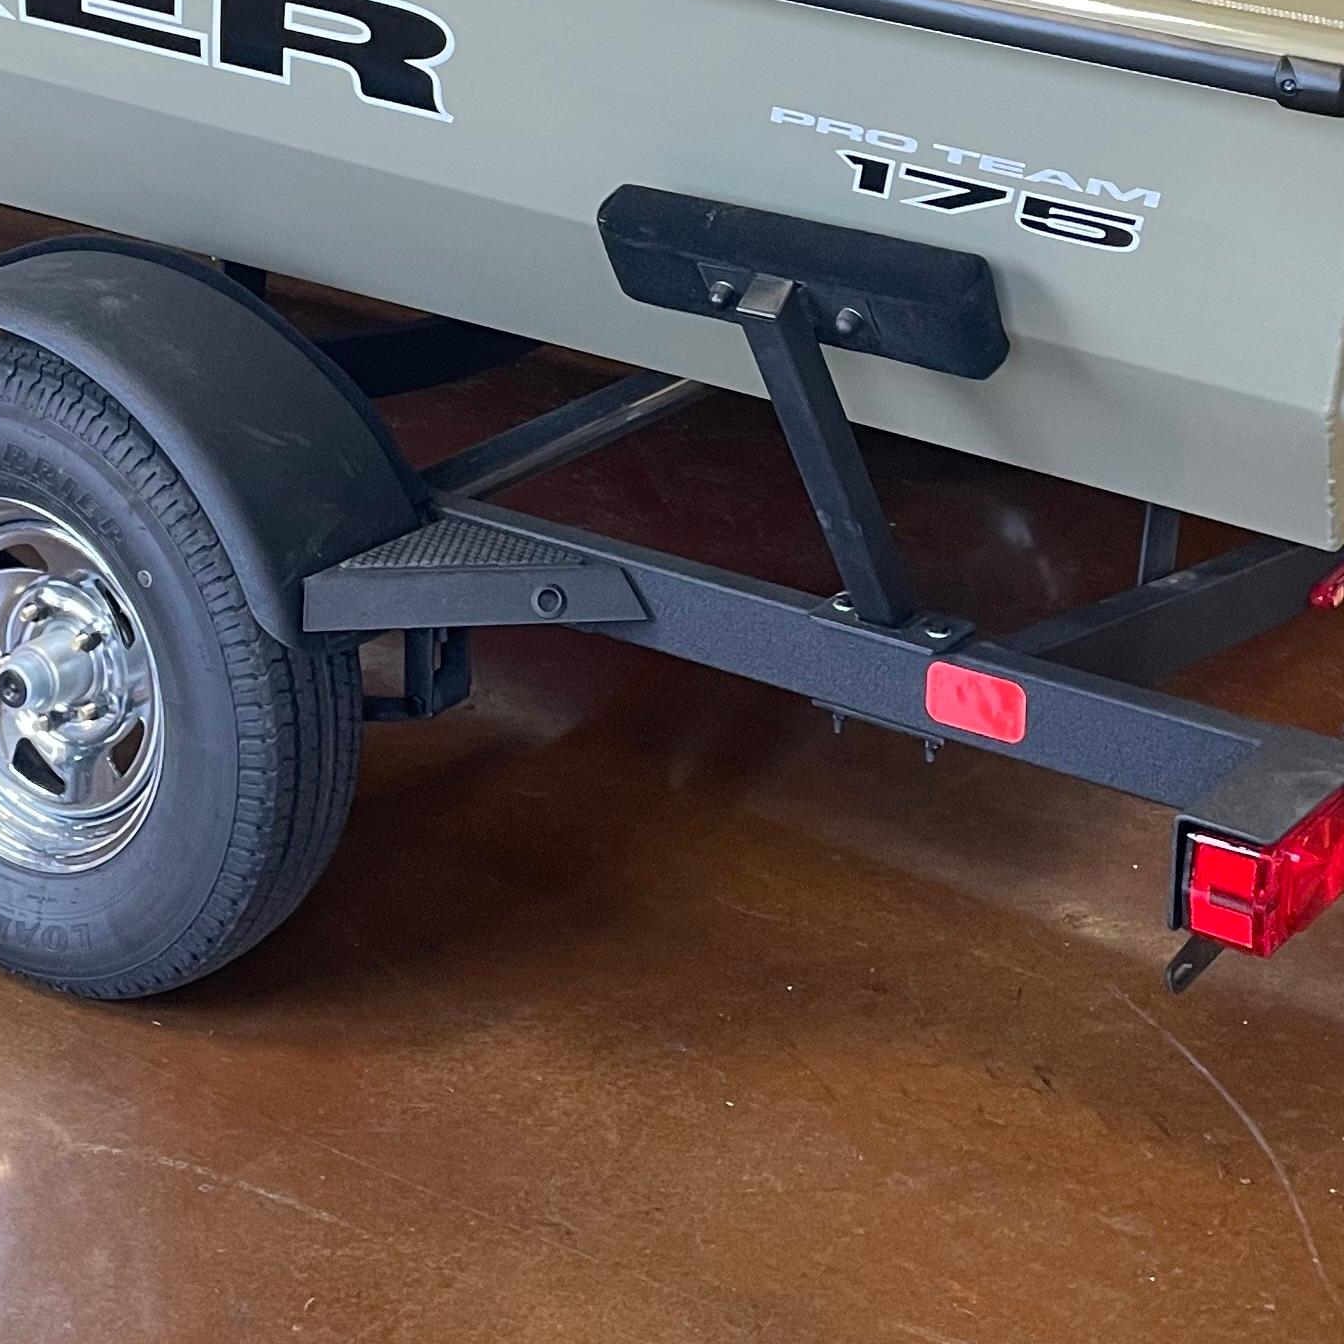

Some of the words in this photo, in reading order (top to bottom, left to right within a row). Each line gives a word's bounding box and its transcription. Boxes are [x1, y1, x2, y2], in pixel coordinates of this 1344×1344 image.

[770, 106, 918, 154] PRO
[933, 143, 1161, 209] TEAM
[835, 149, 1145, 253] 175
